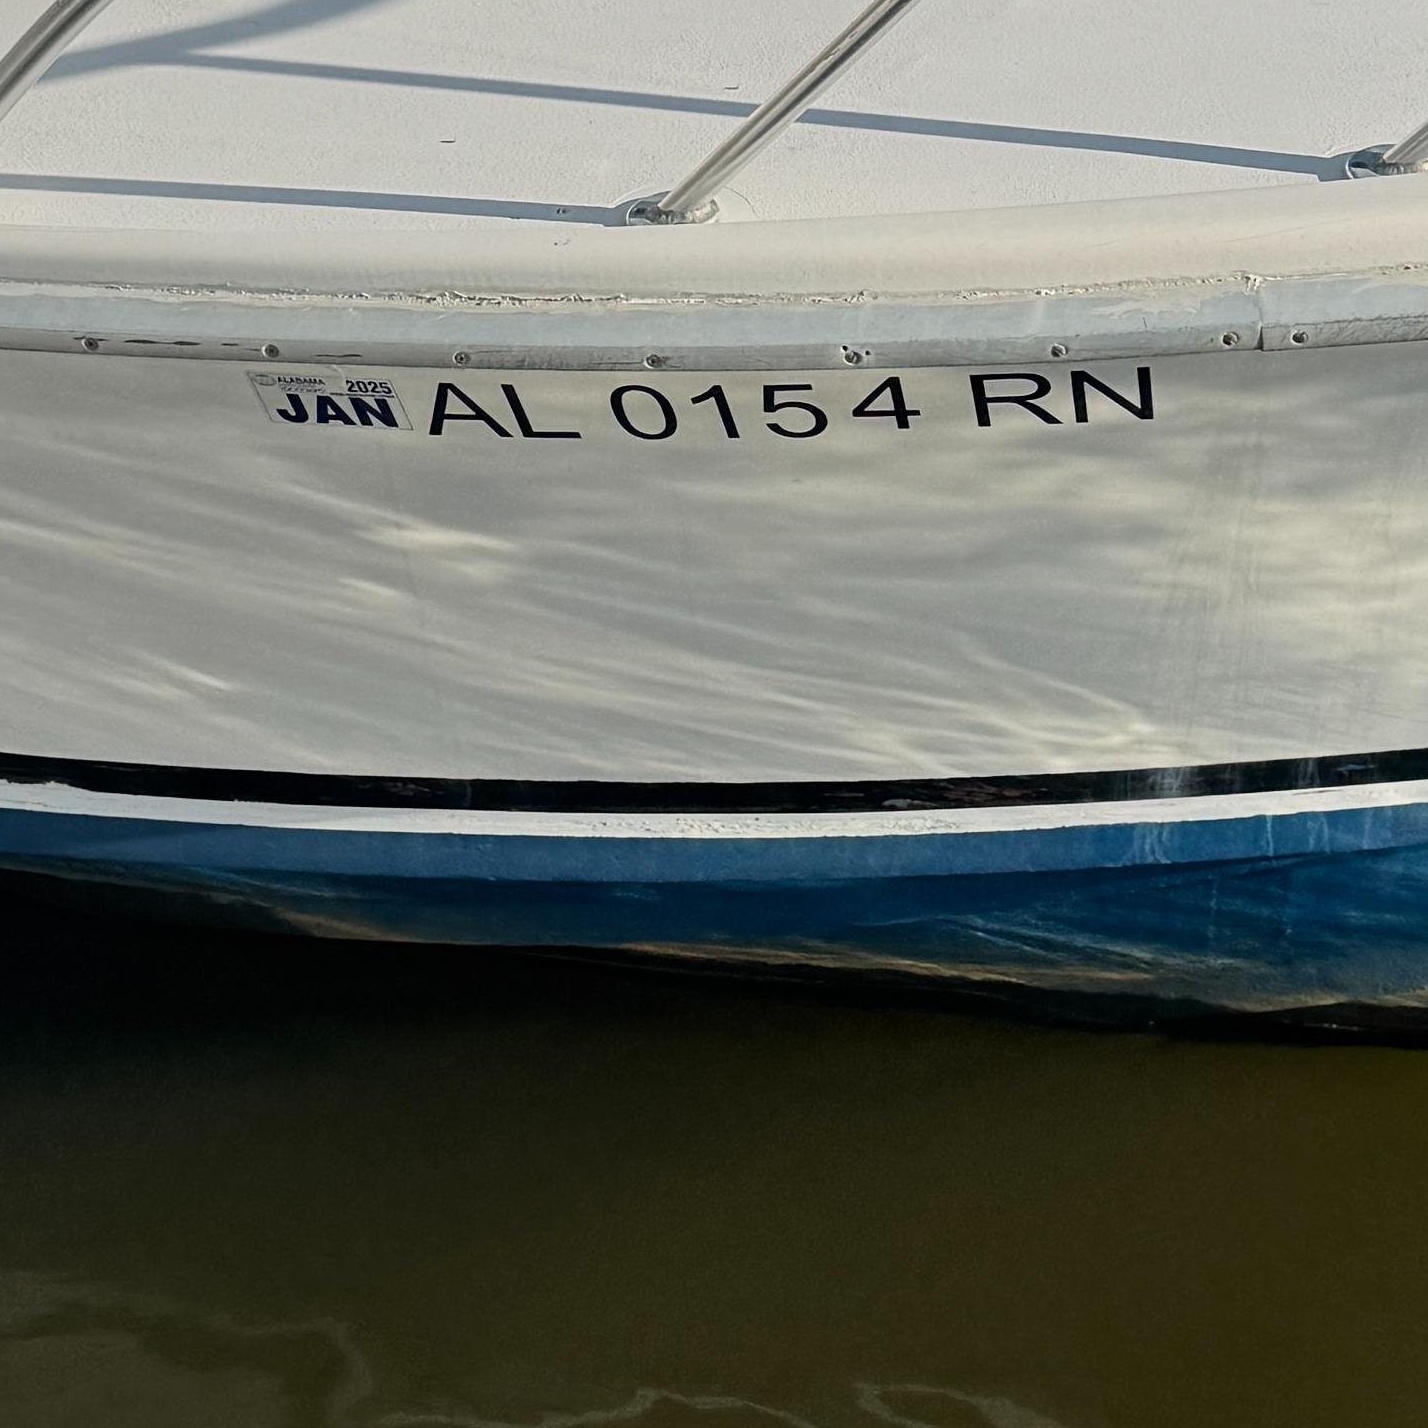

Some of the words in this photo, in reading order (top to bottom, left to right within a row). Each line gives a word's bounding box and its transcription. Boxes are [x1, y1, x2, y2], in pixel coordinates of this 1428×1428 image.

[277, 376, 326, 386] ALABAMA
[345, 379, 393, 394] 2025
[276, 393, 399, 428] JAN
[428, 382, 582, 439] AL
[609, 376, 921, 440] 0154
[968, 366, 1154, 427] RN
